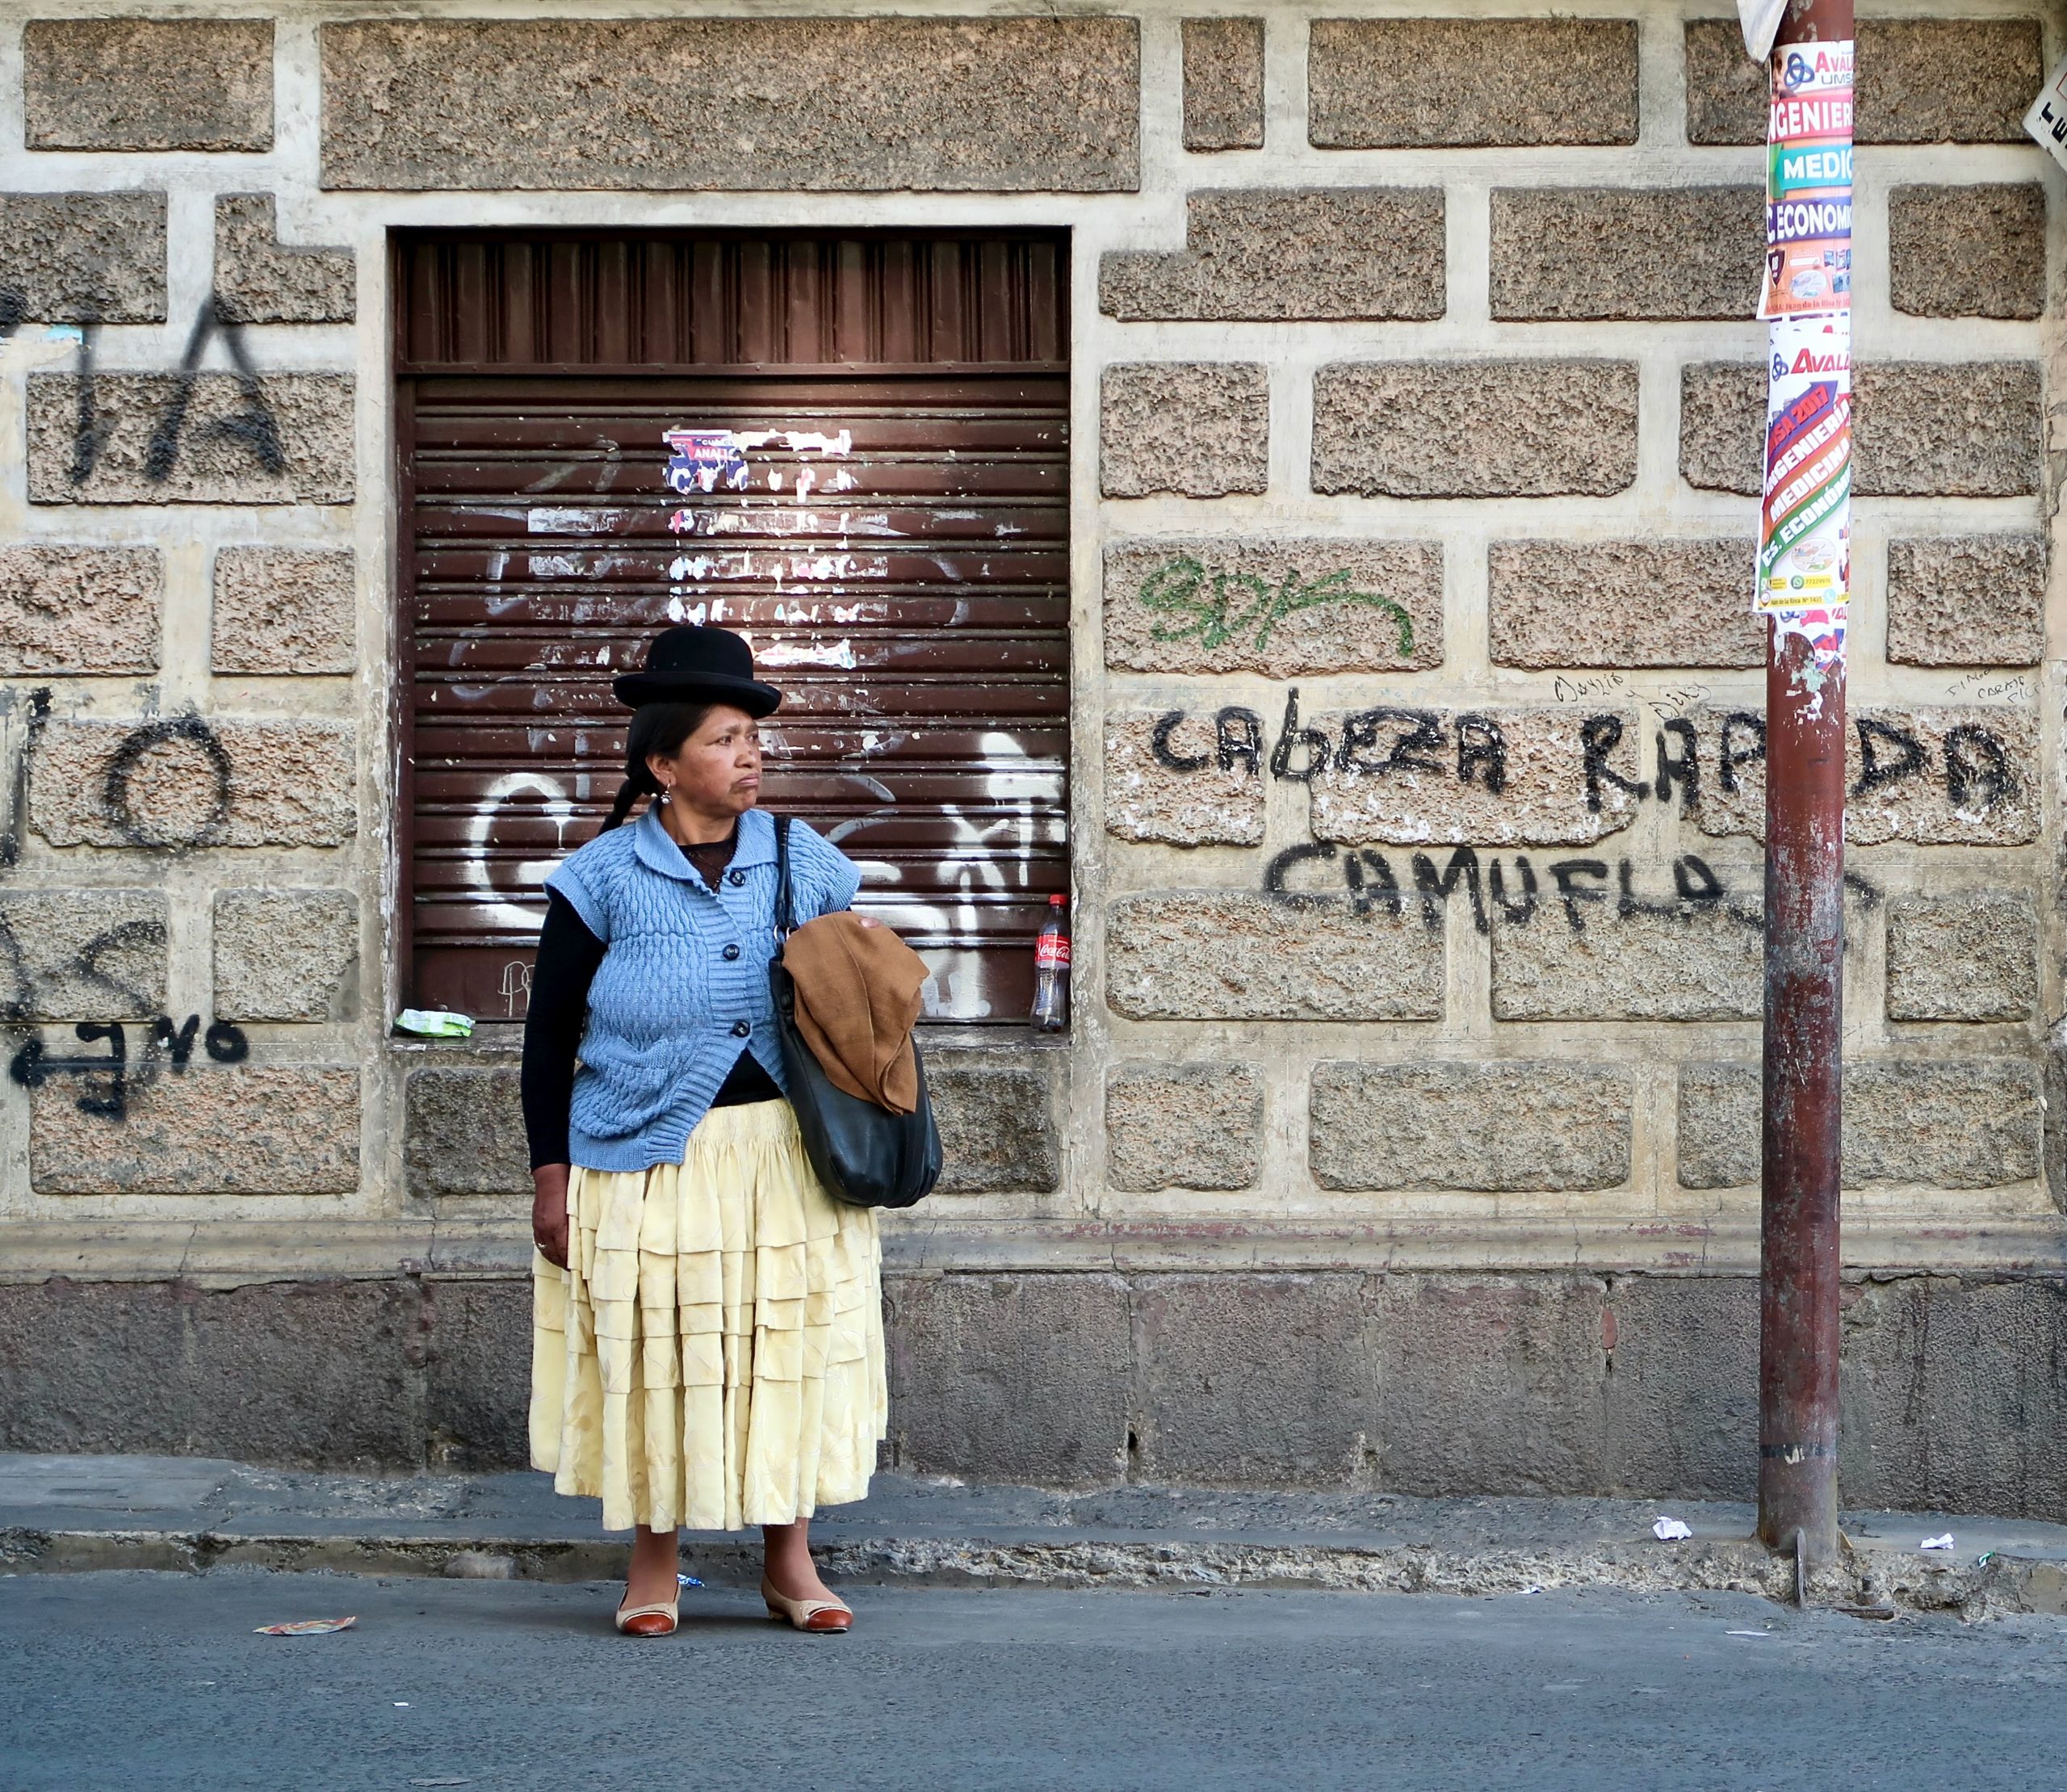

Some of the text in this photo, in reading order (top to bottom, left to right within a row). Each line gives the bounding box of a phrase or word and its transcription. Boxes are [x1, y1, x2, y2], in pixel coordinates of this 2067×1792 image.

[1822, 73, 1854, 85] UMS
[1790, 384, 1830, 426] 2017
[1580, 711, 2020, 817] RAPDA
